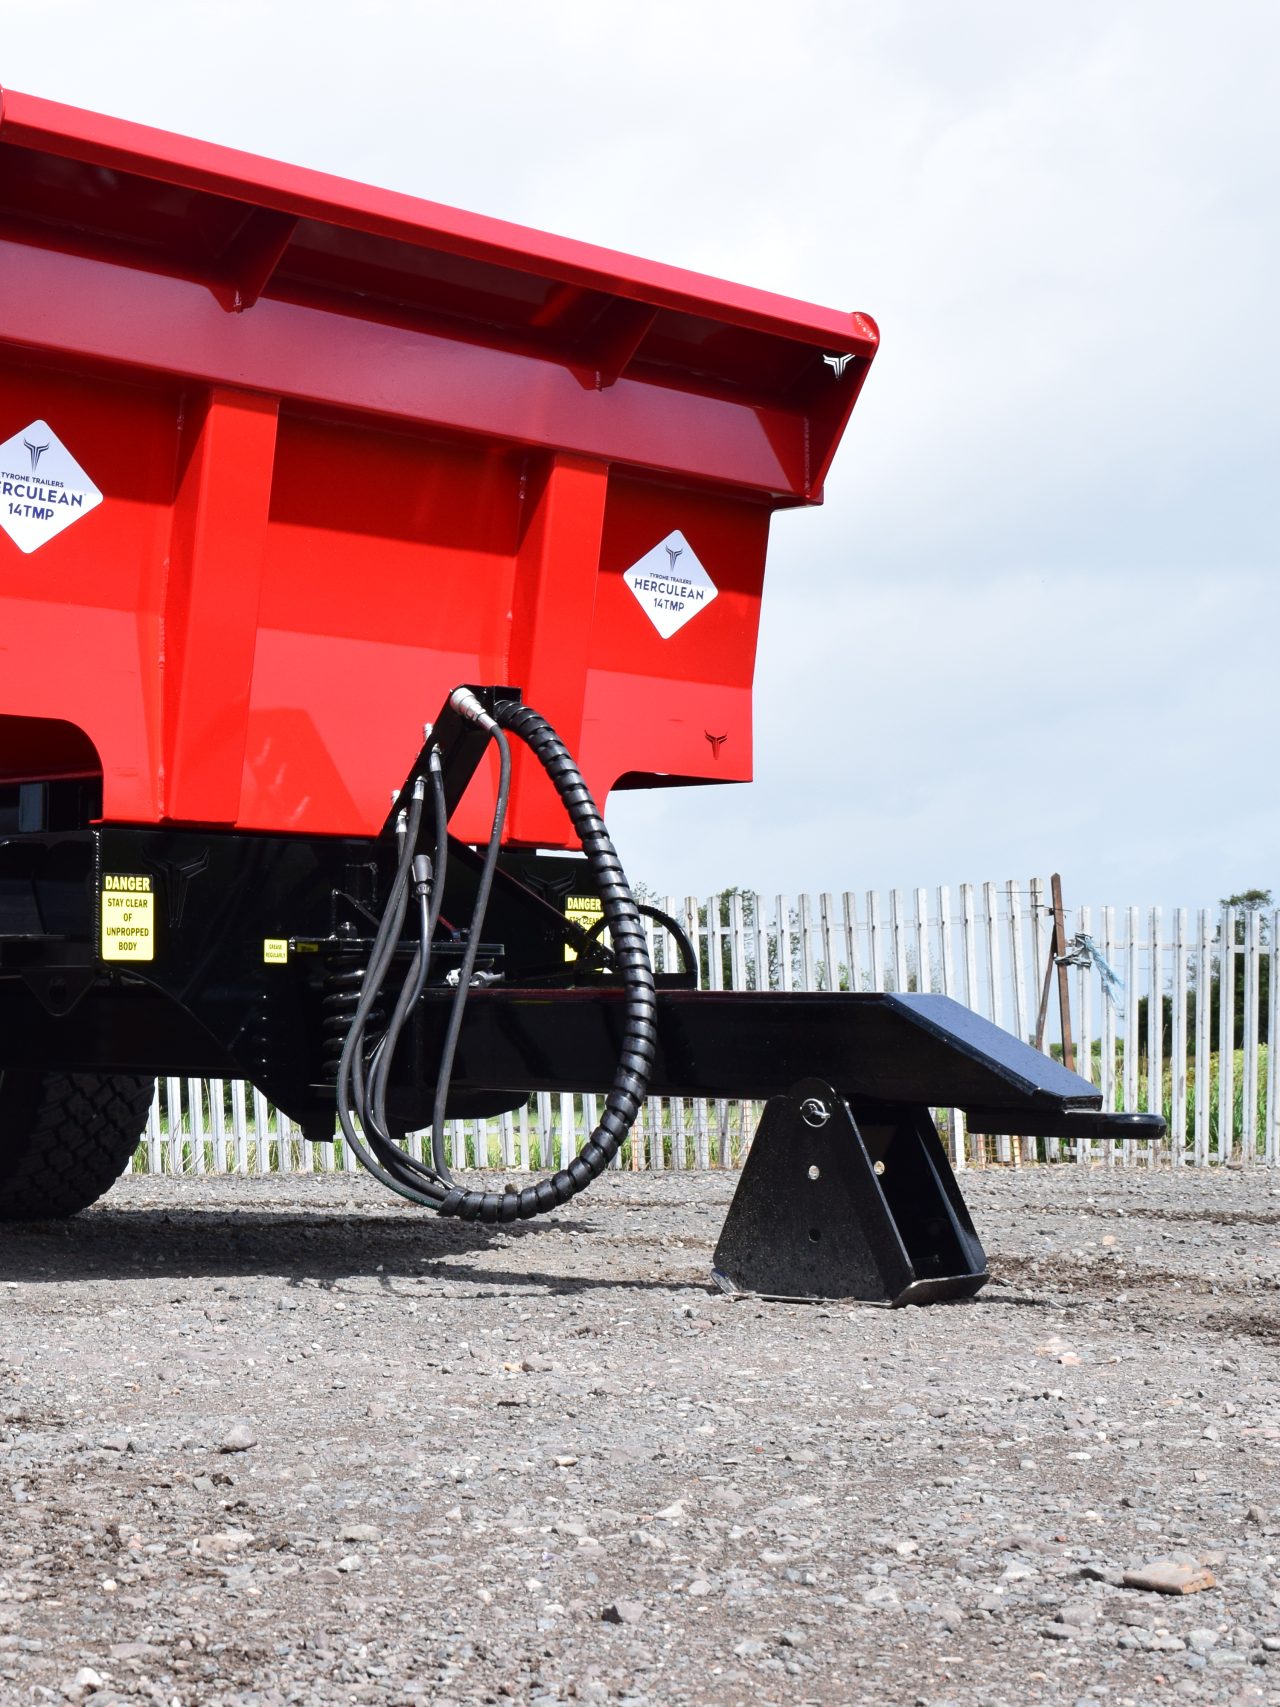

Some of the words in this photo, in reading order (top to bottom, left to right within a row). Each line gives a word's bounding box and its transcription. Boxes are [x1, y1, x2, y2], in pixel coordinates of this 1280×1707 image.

[1, 472, 30, 482] TYRONE
[32, 477, 64, 488] TRAILERS
[8, 503, 54, 520] 14TMP
[670, 576, 692, 585] TRAILERS
[634, 578, 704, 600] HERCULEAN
[654, 598, 685, 612] 14TMP
[105, 876, 150, 891] DANGER
[108, 898, 124, 908] STAY
[126, 899, 148, 908] CLEAR
[568, 897, 601, 911] DANGER
[123, 913, 132, 922] OF
[106, 927, 149, 937] UNPROPPED
[118, 942, 137, 951] BODY
